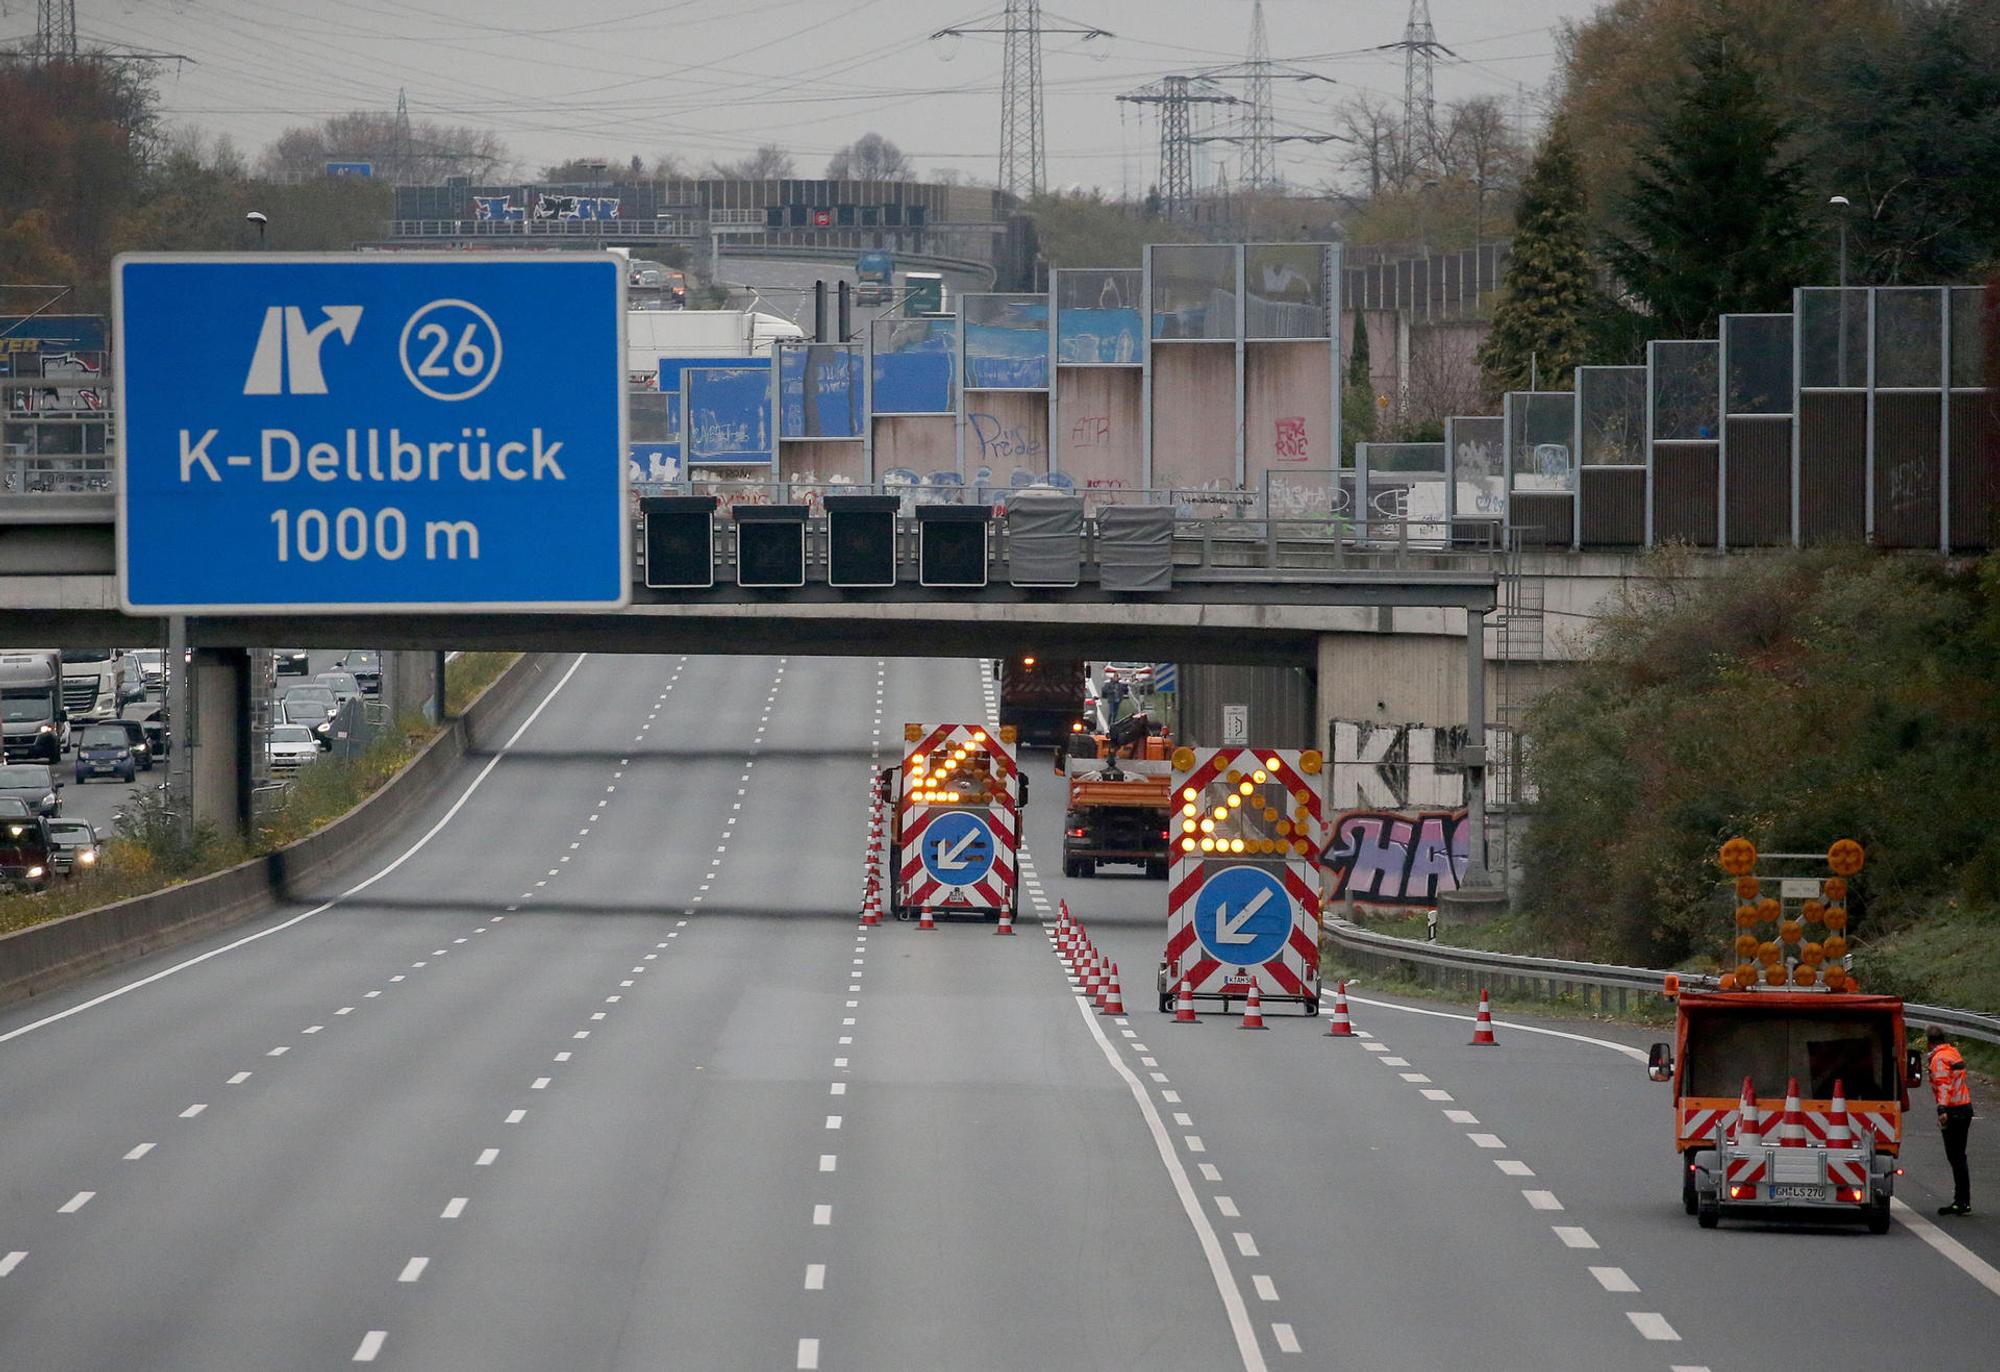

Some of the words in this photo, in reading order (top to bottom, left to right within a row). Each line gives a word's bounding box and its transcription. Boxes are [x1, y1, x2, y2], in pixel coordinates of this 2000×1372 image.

[417, 323, 485, 377] 26
[180, 428, 564, 481] K-Dellbrück
[272, 508, 406, 561] 1000
[426, 522, 478, 559] m
